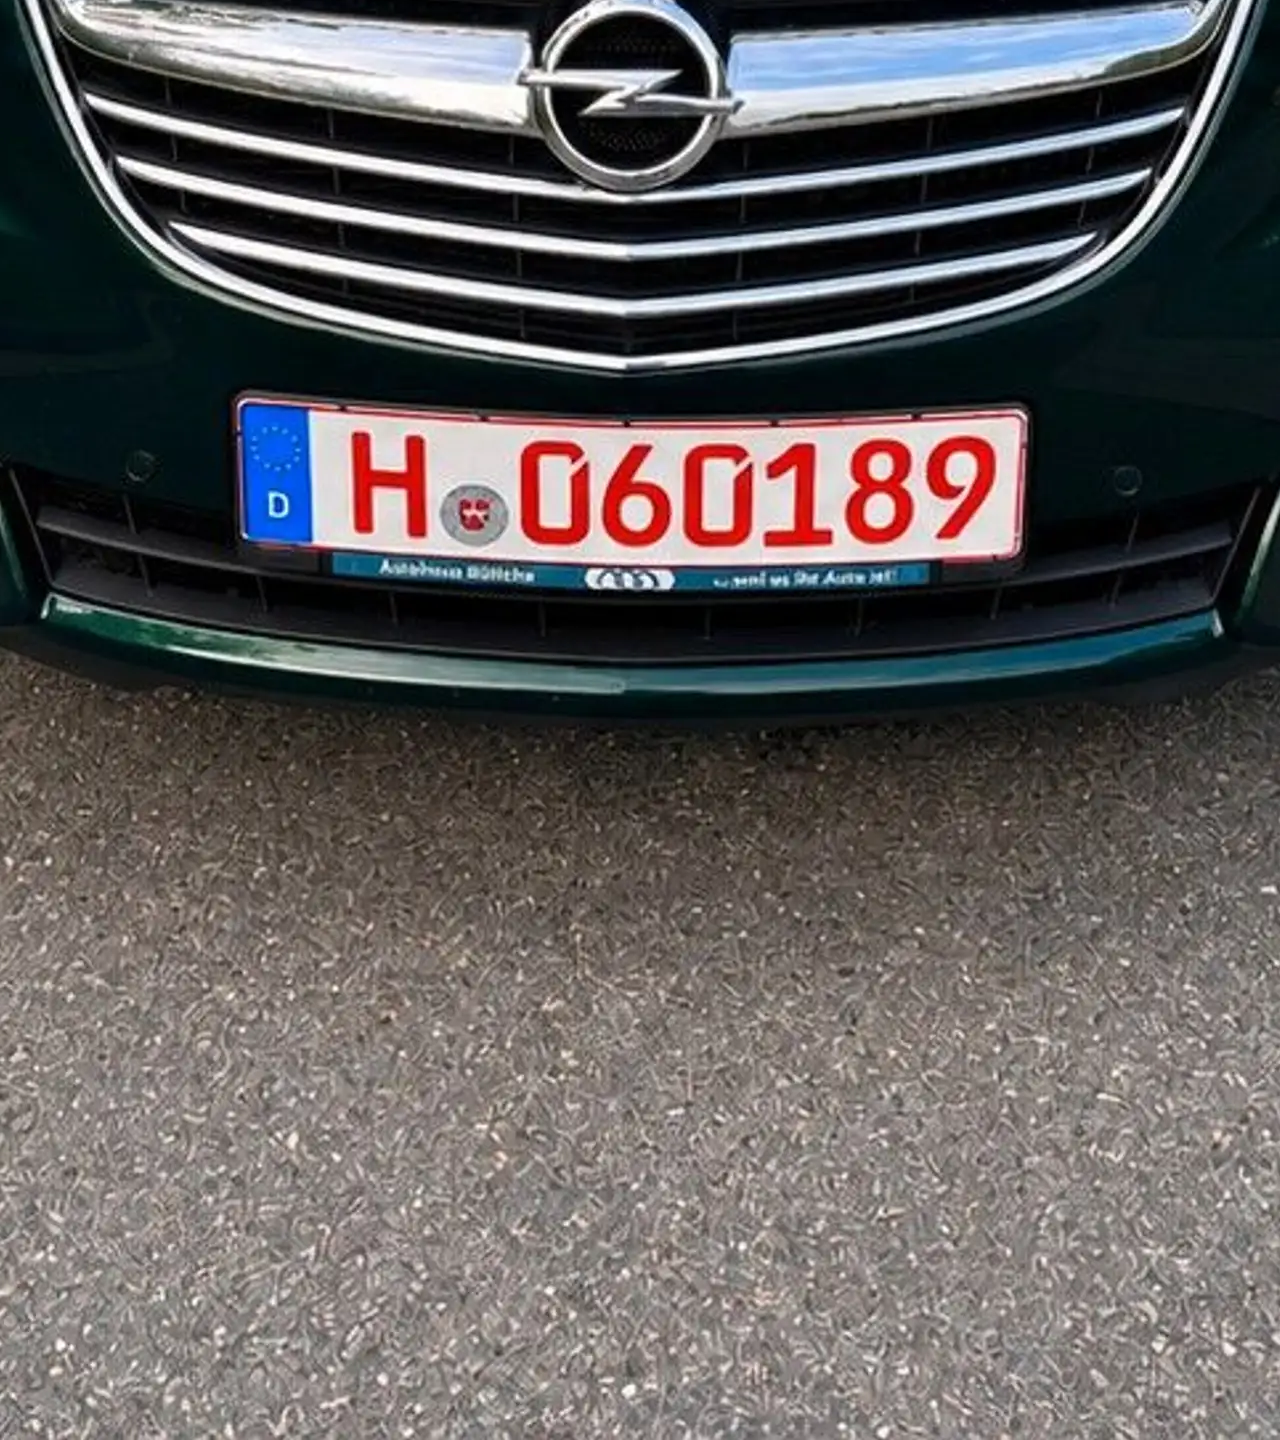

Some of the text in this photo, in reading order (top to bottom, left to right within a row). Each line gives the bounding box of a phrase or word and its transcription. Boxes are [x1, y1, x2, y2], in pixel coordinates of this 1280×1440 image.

[268, 491, 290, 518] D
[351, 431, 997, 548] H 060189
